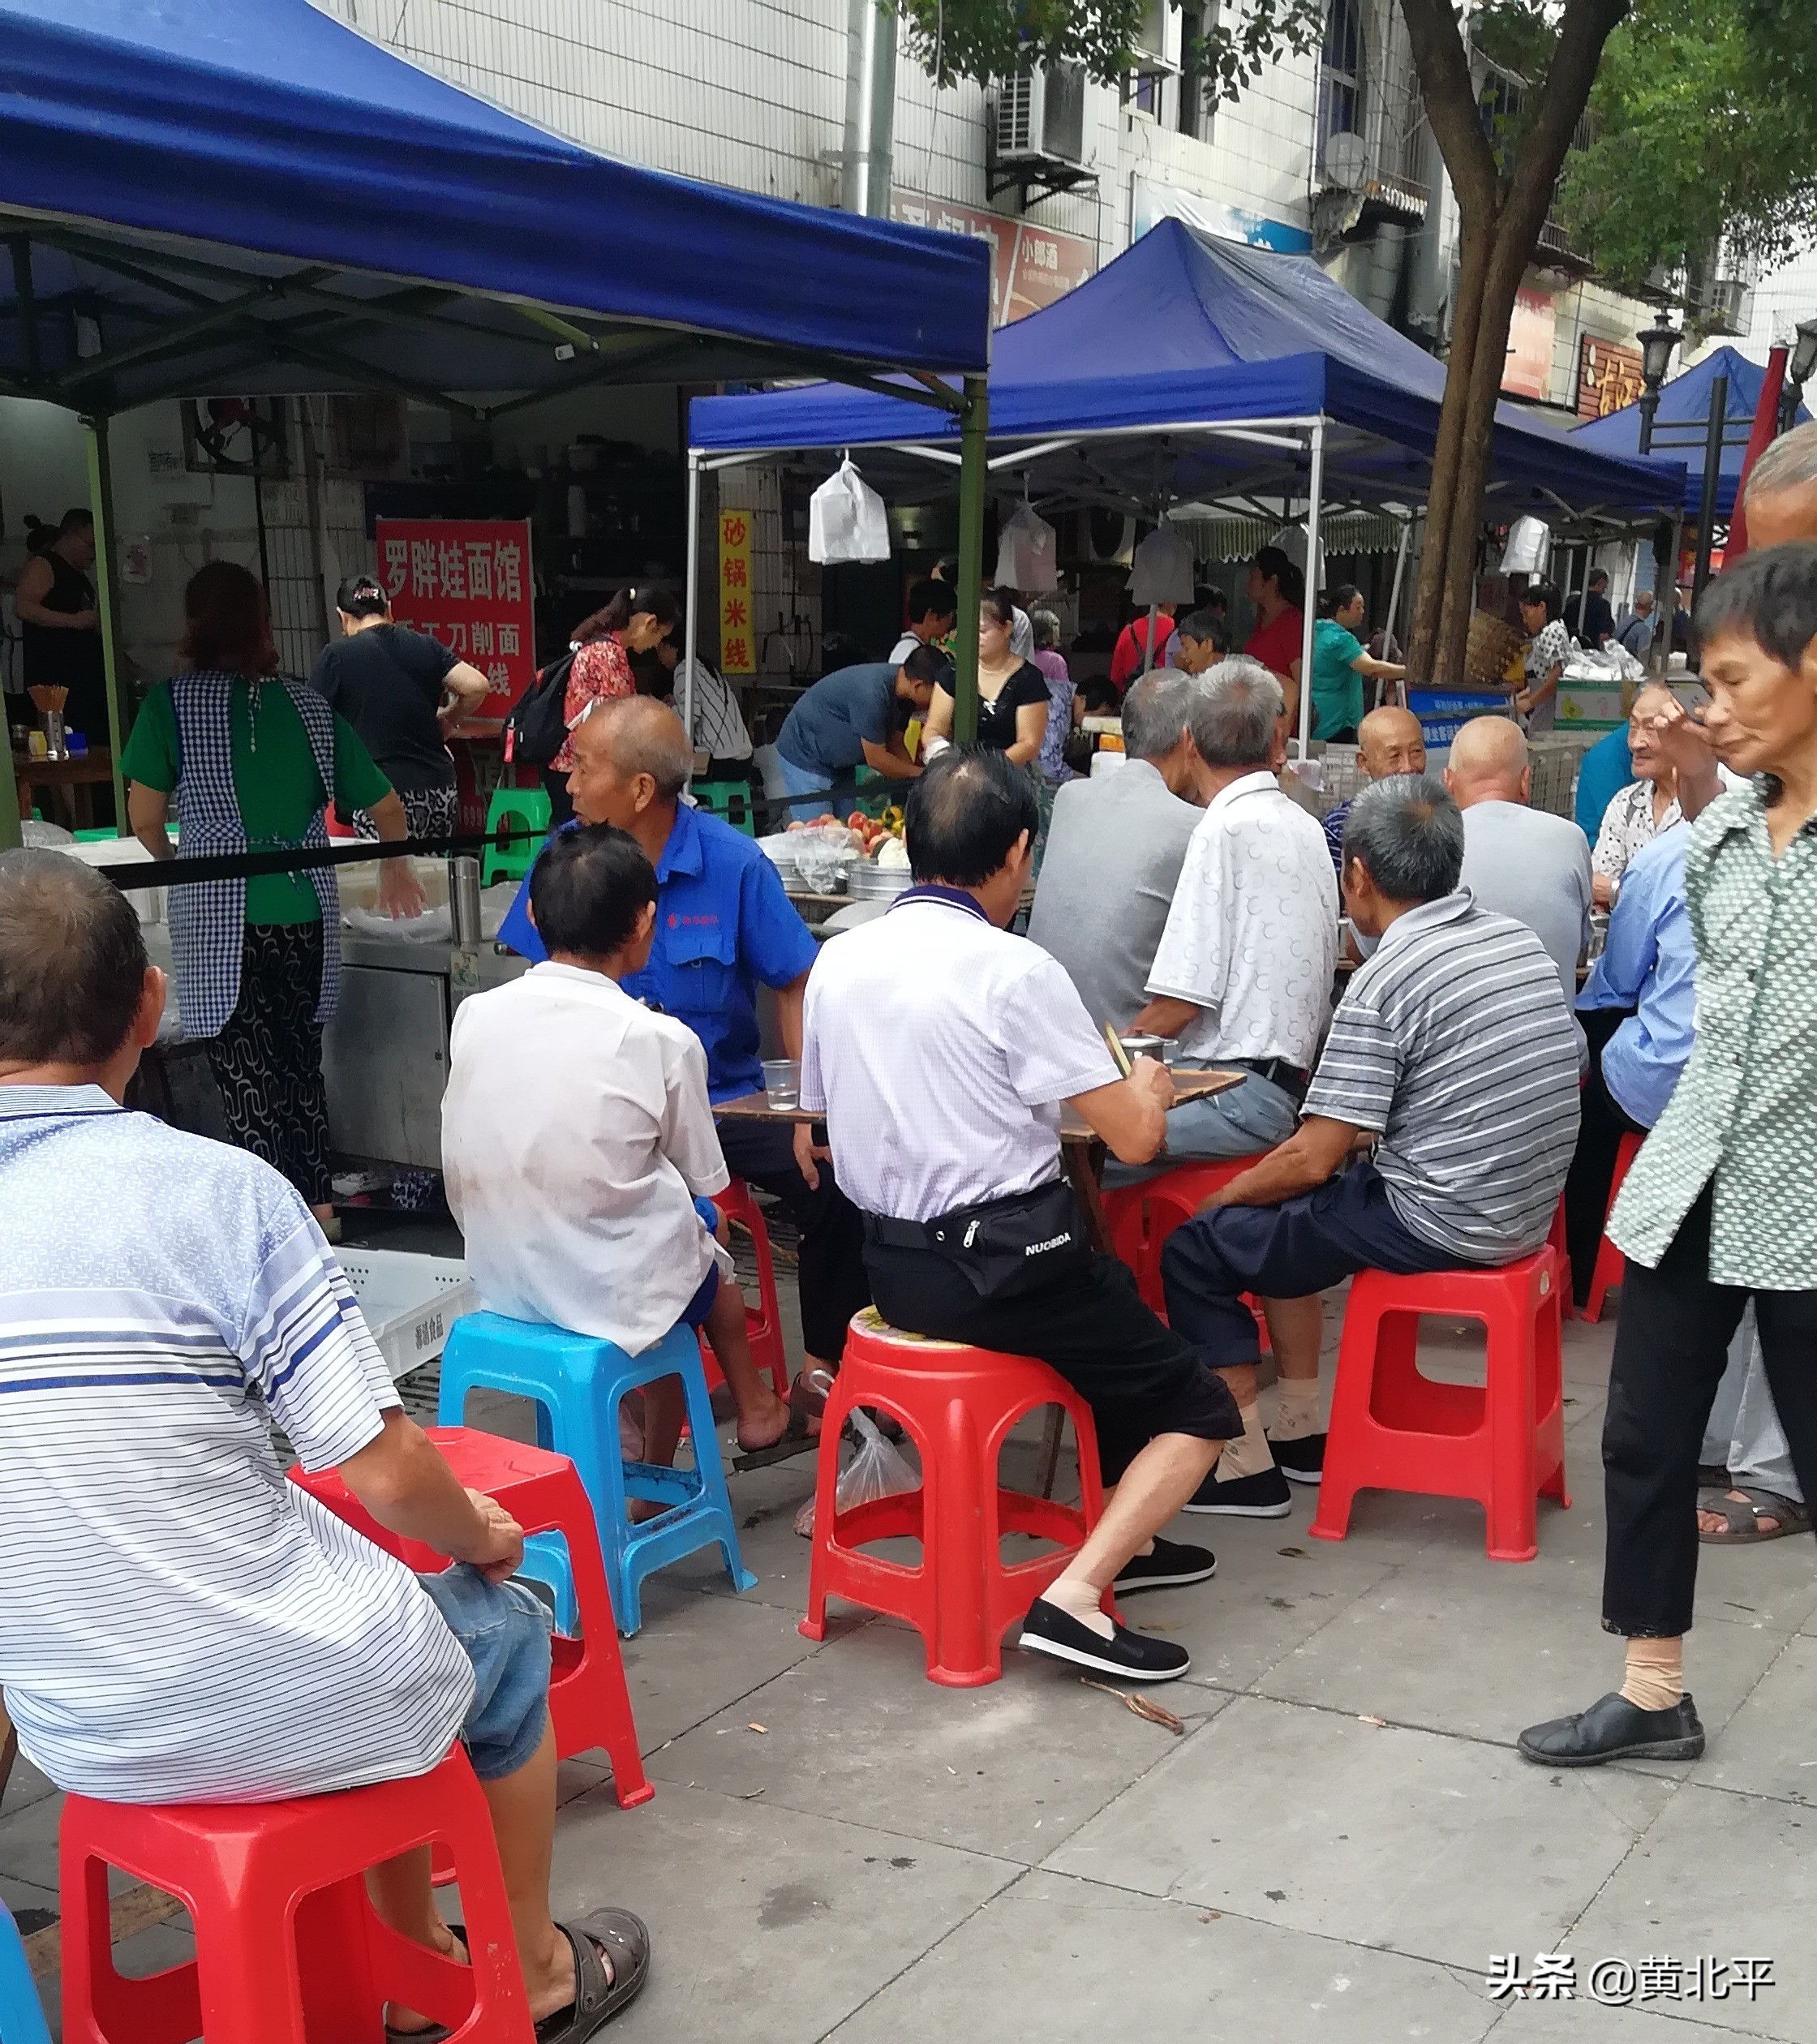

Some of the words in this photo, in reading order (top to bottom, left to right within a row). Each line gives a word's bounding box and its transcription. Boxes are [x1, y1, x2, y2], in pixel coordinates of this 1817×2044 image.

[385, 539, 522, 602] 罗胖娃面馆
[723, 517, 750, 668] 砂锅米线
